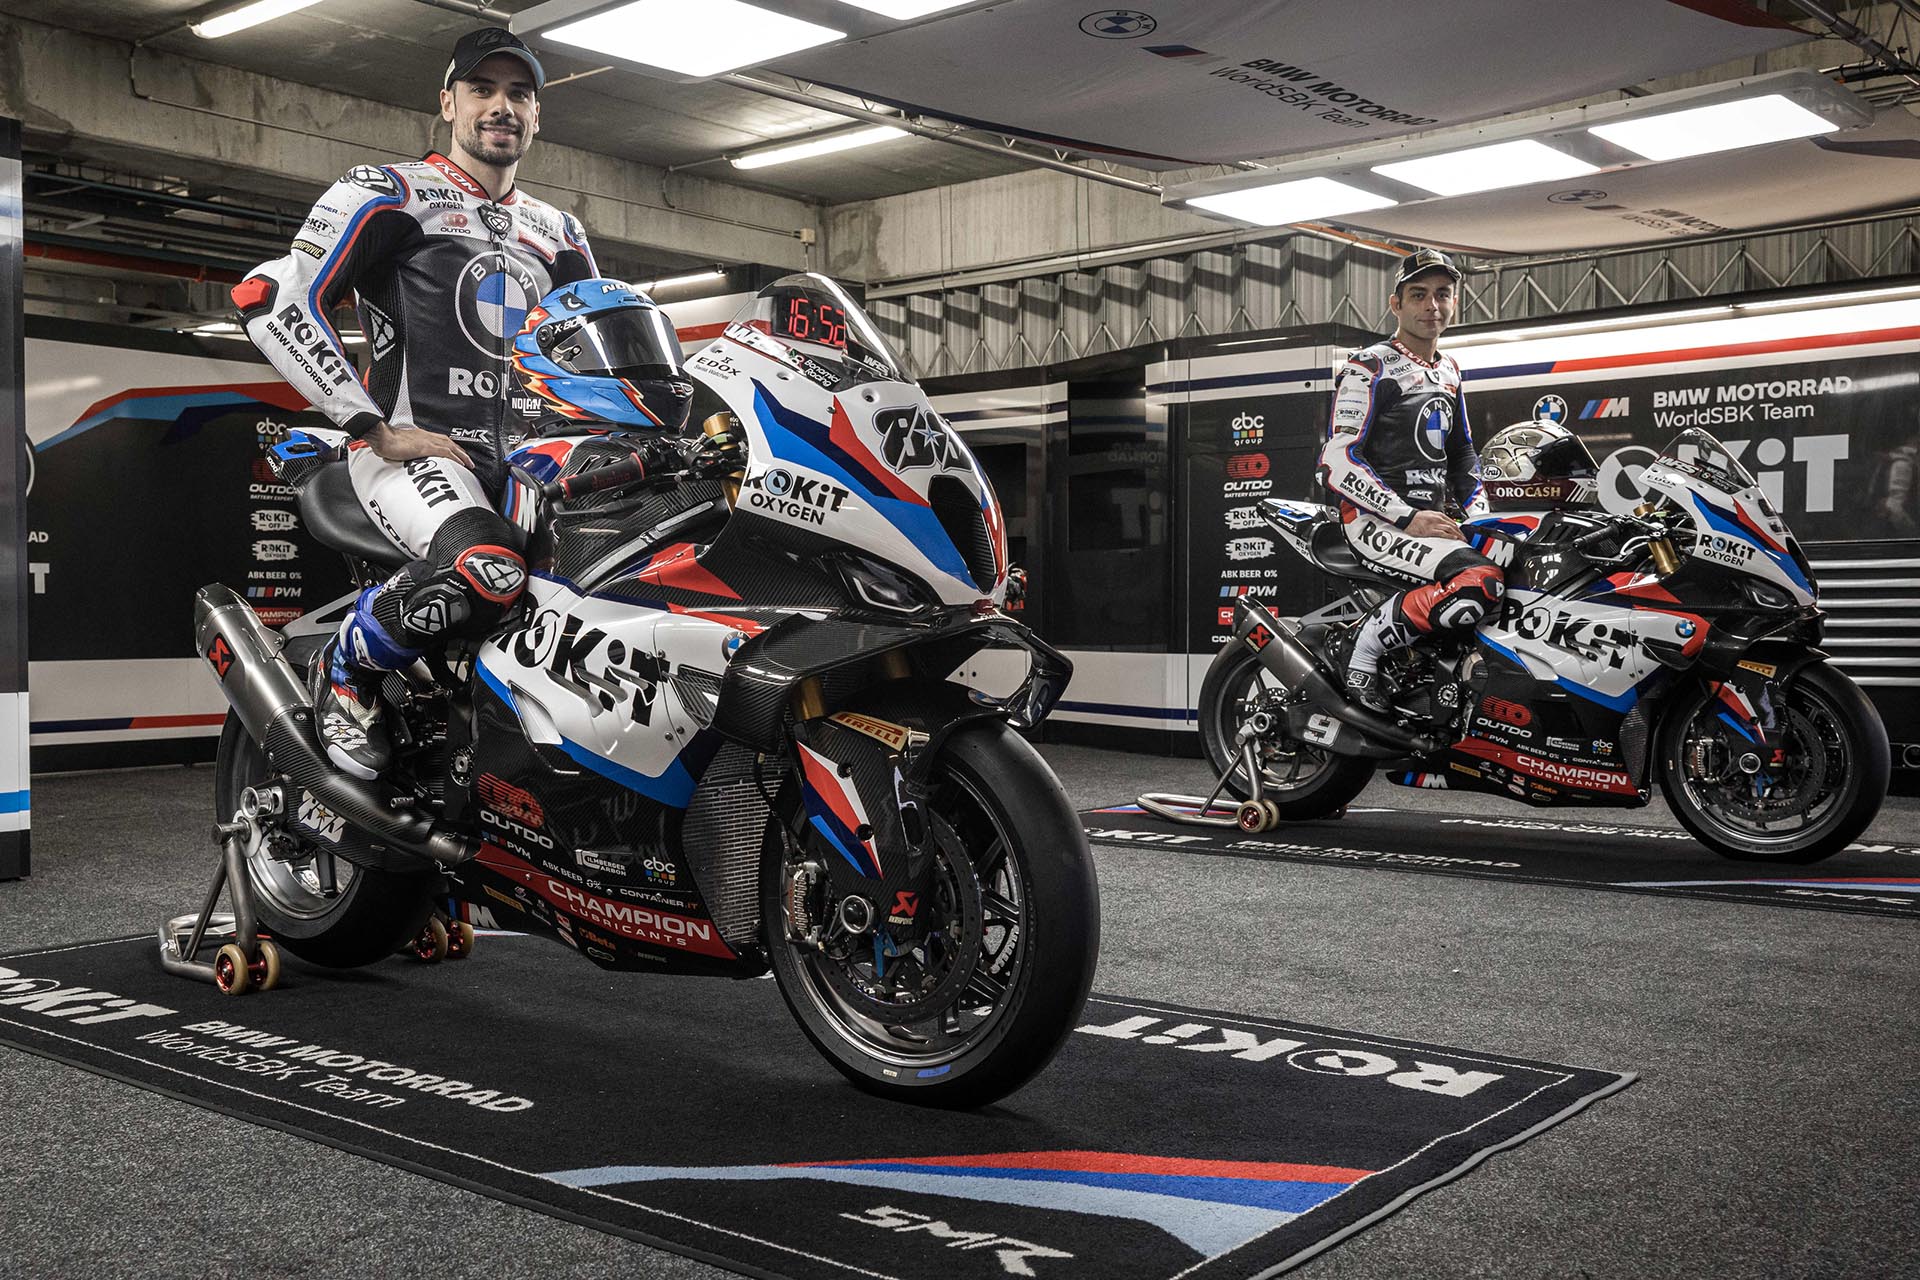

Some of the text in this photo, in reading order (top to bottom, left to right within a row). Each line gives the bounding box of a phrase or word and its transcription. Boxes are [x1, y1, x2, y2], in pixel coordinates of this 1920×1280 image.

[1209, 66, 1370, 129] WorldSBK Team
[1240, 58, 1438, 126] BMW MOTORRAD
[429, 201, 464, 210] OXYGEN
[440, 227, 471, 235] OUTDO
[532, 225, 548, 238] OFF
[276, 303, 352, 386] ROKiT
[266, 321, 333, 397] BMW MOTORRAD
[697, 357, 741, 376] EDOX
[1653, 376, 1853, 409] BMW MOTORRAD
[512, 398, 541, 416] NOLAN
[1652, 401, 1815, 429] WorldSBK Team
[1232, 411, 1264, 430] ebc
[1234, 438, 1263, 447] group
[1223, 480, 1273, 491] OUTDO
[1342, 471, 1392, 507] ROKiT
[1339, 483, 1387, 513] BMW MOTORRAD
[750, 492, 825, 526] OXYGEN
[1234, 542, 1266, 551] ROKiT
[1358, 521, 1433, 566] ROKiT
[1700, 534, 1756, 560] ROKiT
[1703, 549, 1744, 567] OXYGEN
[248, 571, 302, 579] ABK BEER 0%
[1221, 569, 1278, 578] ABK BEER 0%
[274, 587, 302, 598] PVM
[1247, 585, 1278, 597] PVM
[837, 713, 904, 745] PIRELLI
[1476, 717, 1533, 738] OUTDO
[1489, 734, 1509, 745] PVM
[1592, 738, 1614, 749] ebc
[1516, 755, 1627, 785] CHAMPION
[1529, 768, 1609, 789] LUBRICANTS
[480, 810, 554, 850] OUTDO
[507, 841, 531, 859] PVM
[643, 857, 676, 874] ebc
[548, 879, 710, 941] CHAMPION
[569, 903, 687, 946] LUBRICANTS
[181, 1020, 535, 1113] BMW MOTORRAD
[1074, 1014, 1505, 1098] ROKiT
[136, 1029, 407, 1110] WorldSBK Team
